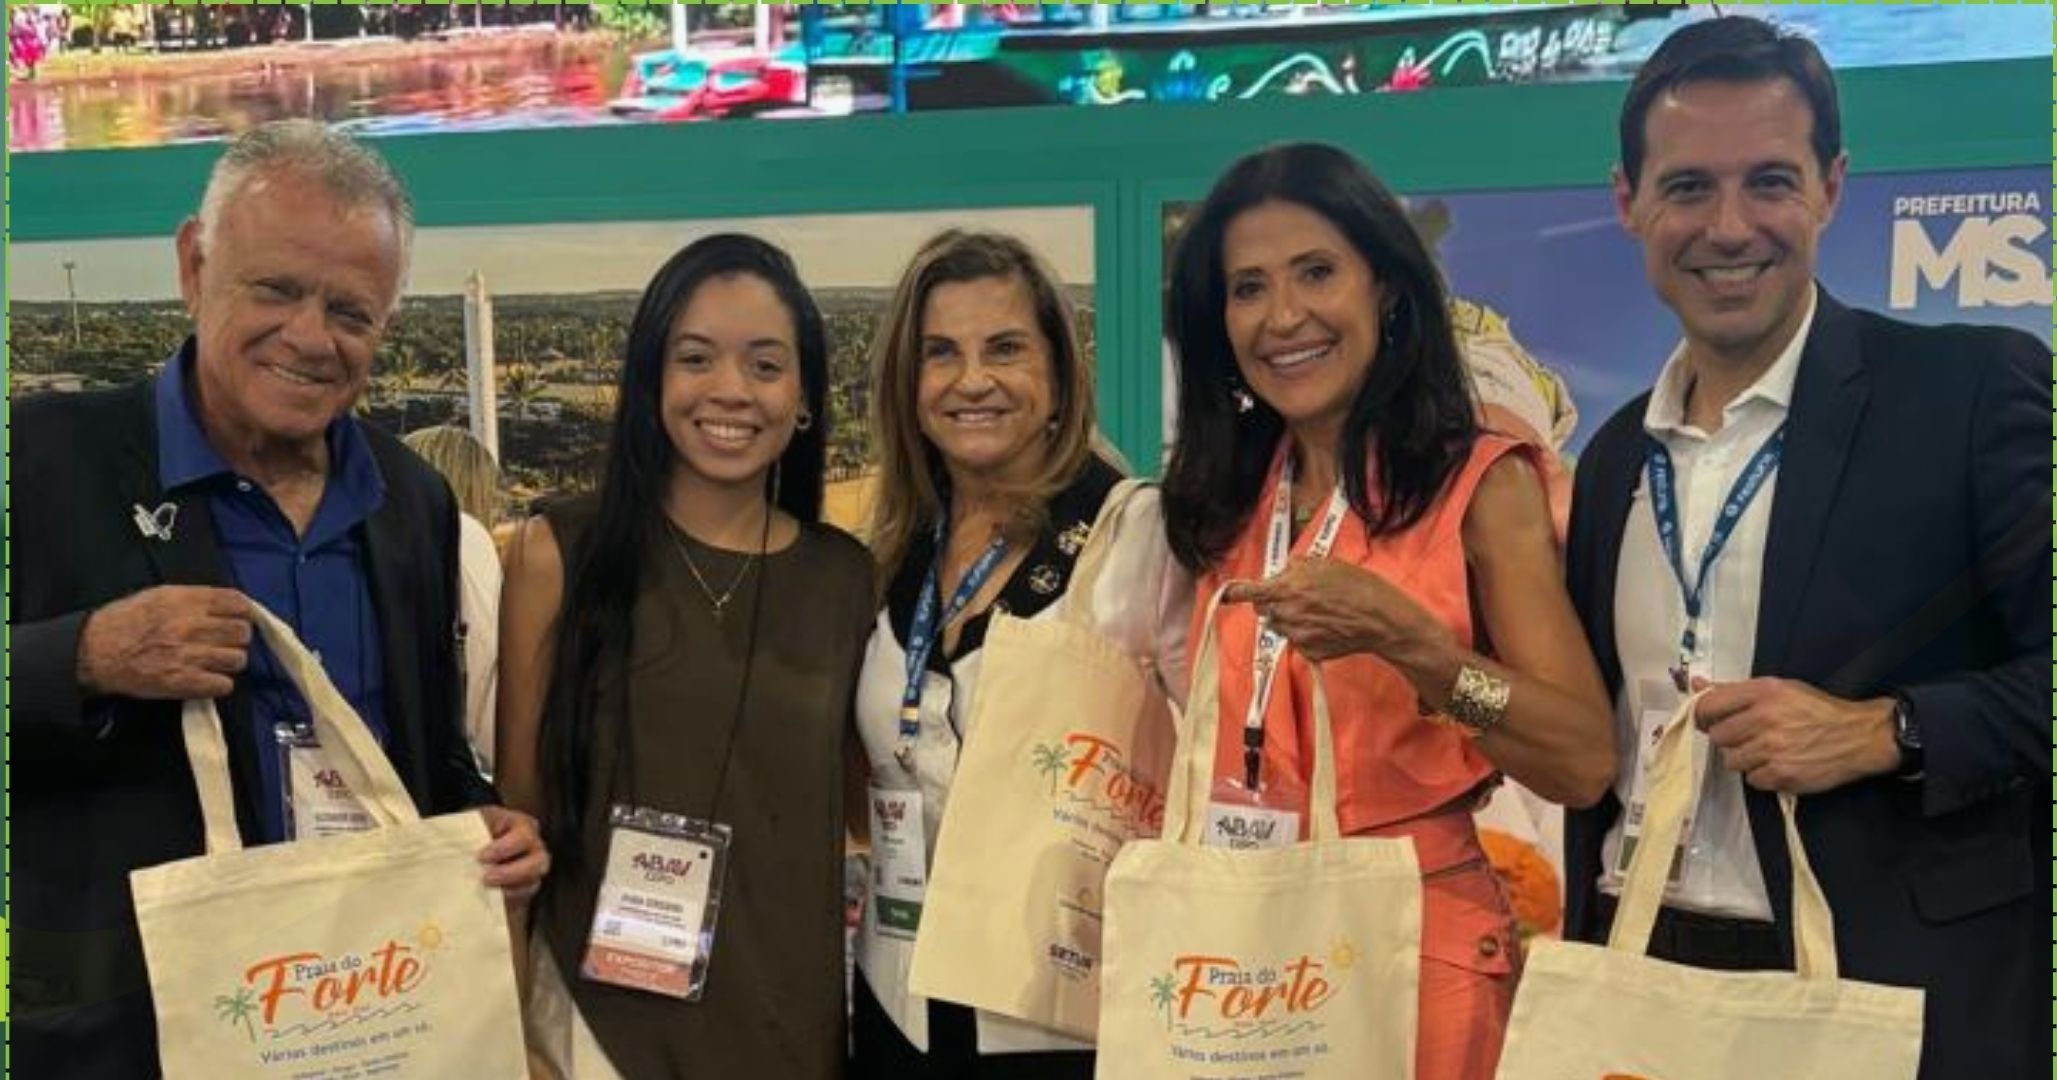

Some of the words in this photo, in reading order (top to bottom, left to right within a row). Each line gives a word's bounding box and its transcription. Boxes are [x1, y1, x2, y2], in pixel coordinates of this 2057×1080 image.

[1893, 192, 2041, 216] PREFEITURA
[246, 939, 428, 1024] Forte
[295, 960, 338, 982] Praia
[340, 955, 362, 971] do
[1208, 968, 1253, 986] Praia
[1255, 966, 1278, 984] do
[1175, 954, 1334, 1020] Forte
